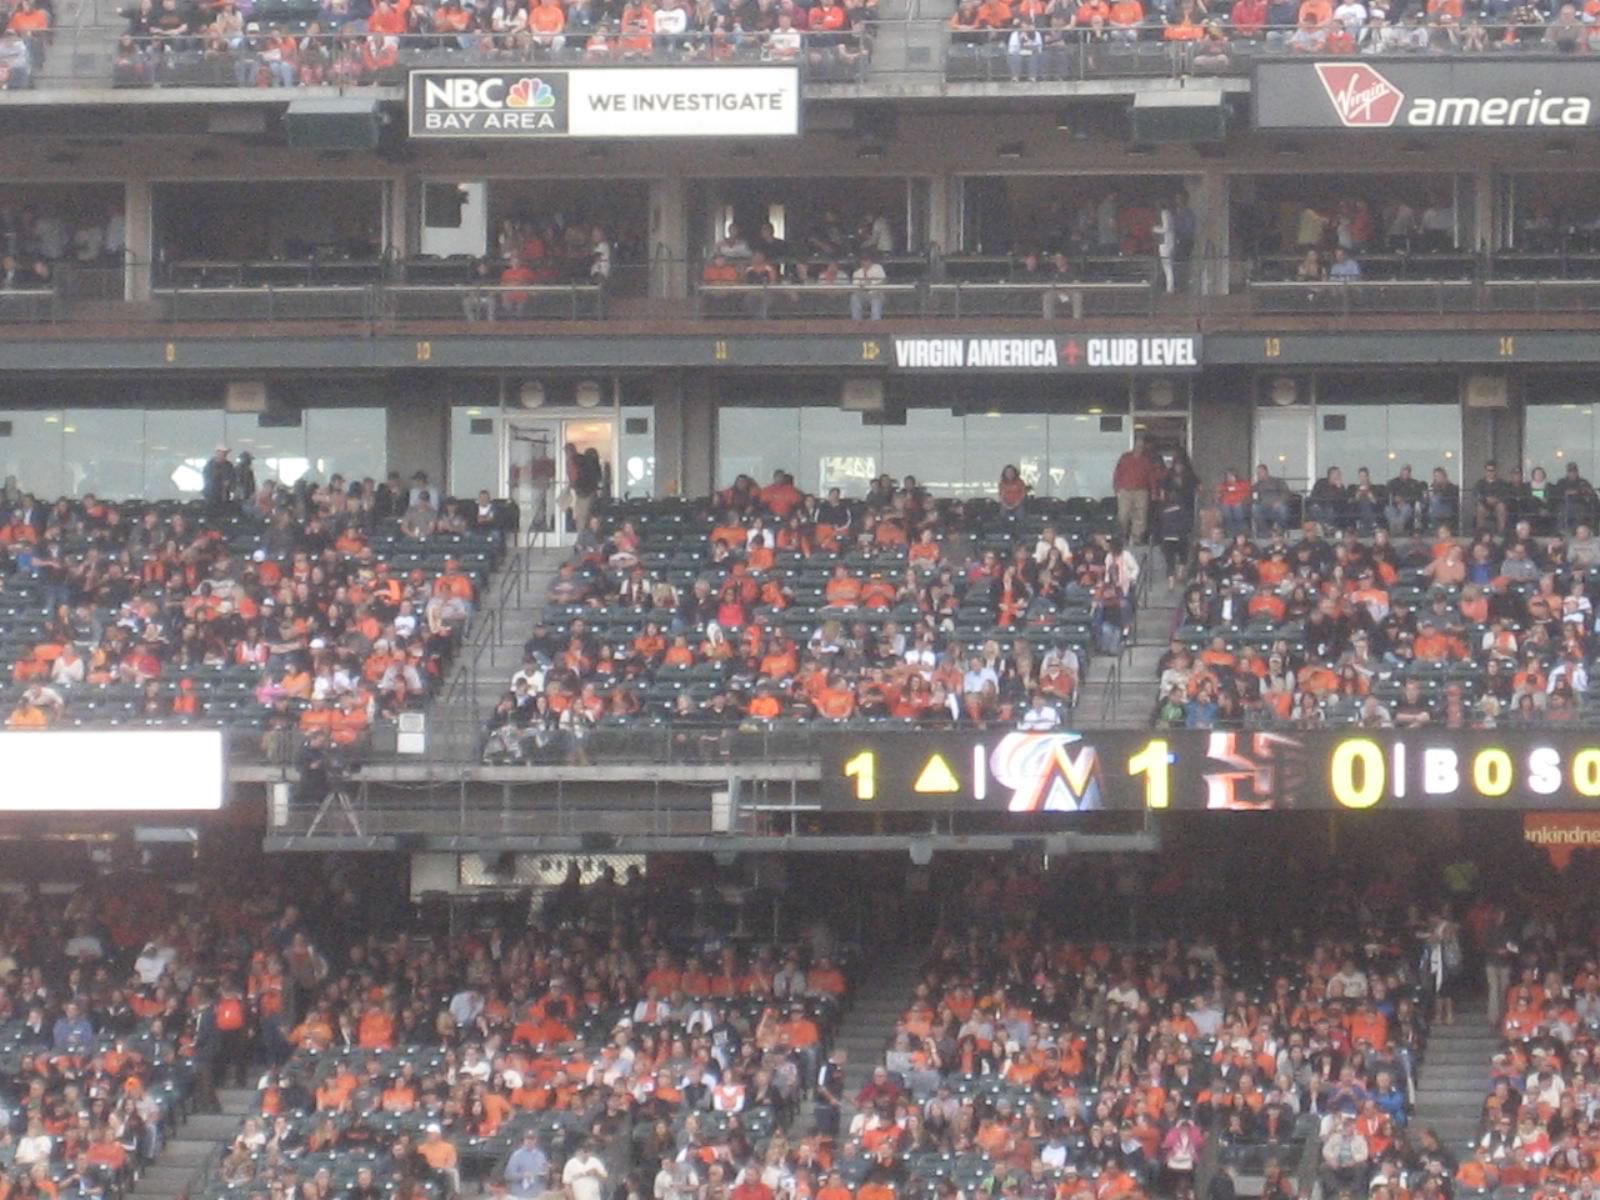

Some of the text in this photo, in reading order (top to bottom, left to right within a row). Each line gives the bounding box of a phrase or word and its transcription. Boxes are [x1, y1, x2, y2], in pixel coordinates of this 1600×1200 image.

[425, 78, 503, 108] NBC
[588, 93, 783, 111] WE INVESTIGATE
[1336, 74, 1591, 126] Virgin america
[425, 113, 555, 129] BAY AREA
[895, 338, 1197, 367] VIRGIN AMERICA CLUB LEVEL
[845, 751, 875, 800] 1
[1128, 740, 1169, 808] 1
[1331, 738, 1385, 808] 0
[1424, 748, 1459, 794] B
[1528, 748, 1562, 794] S
